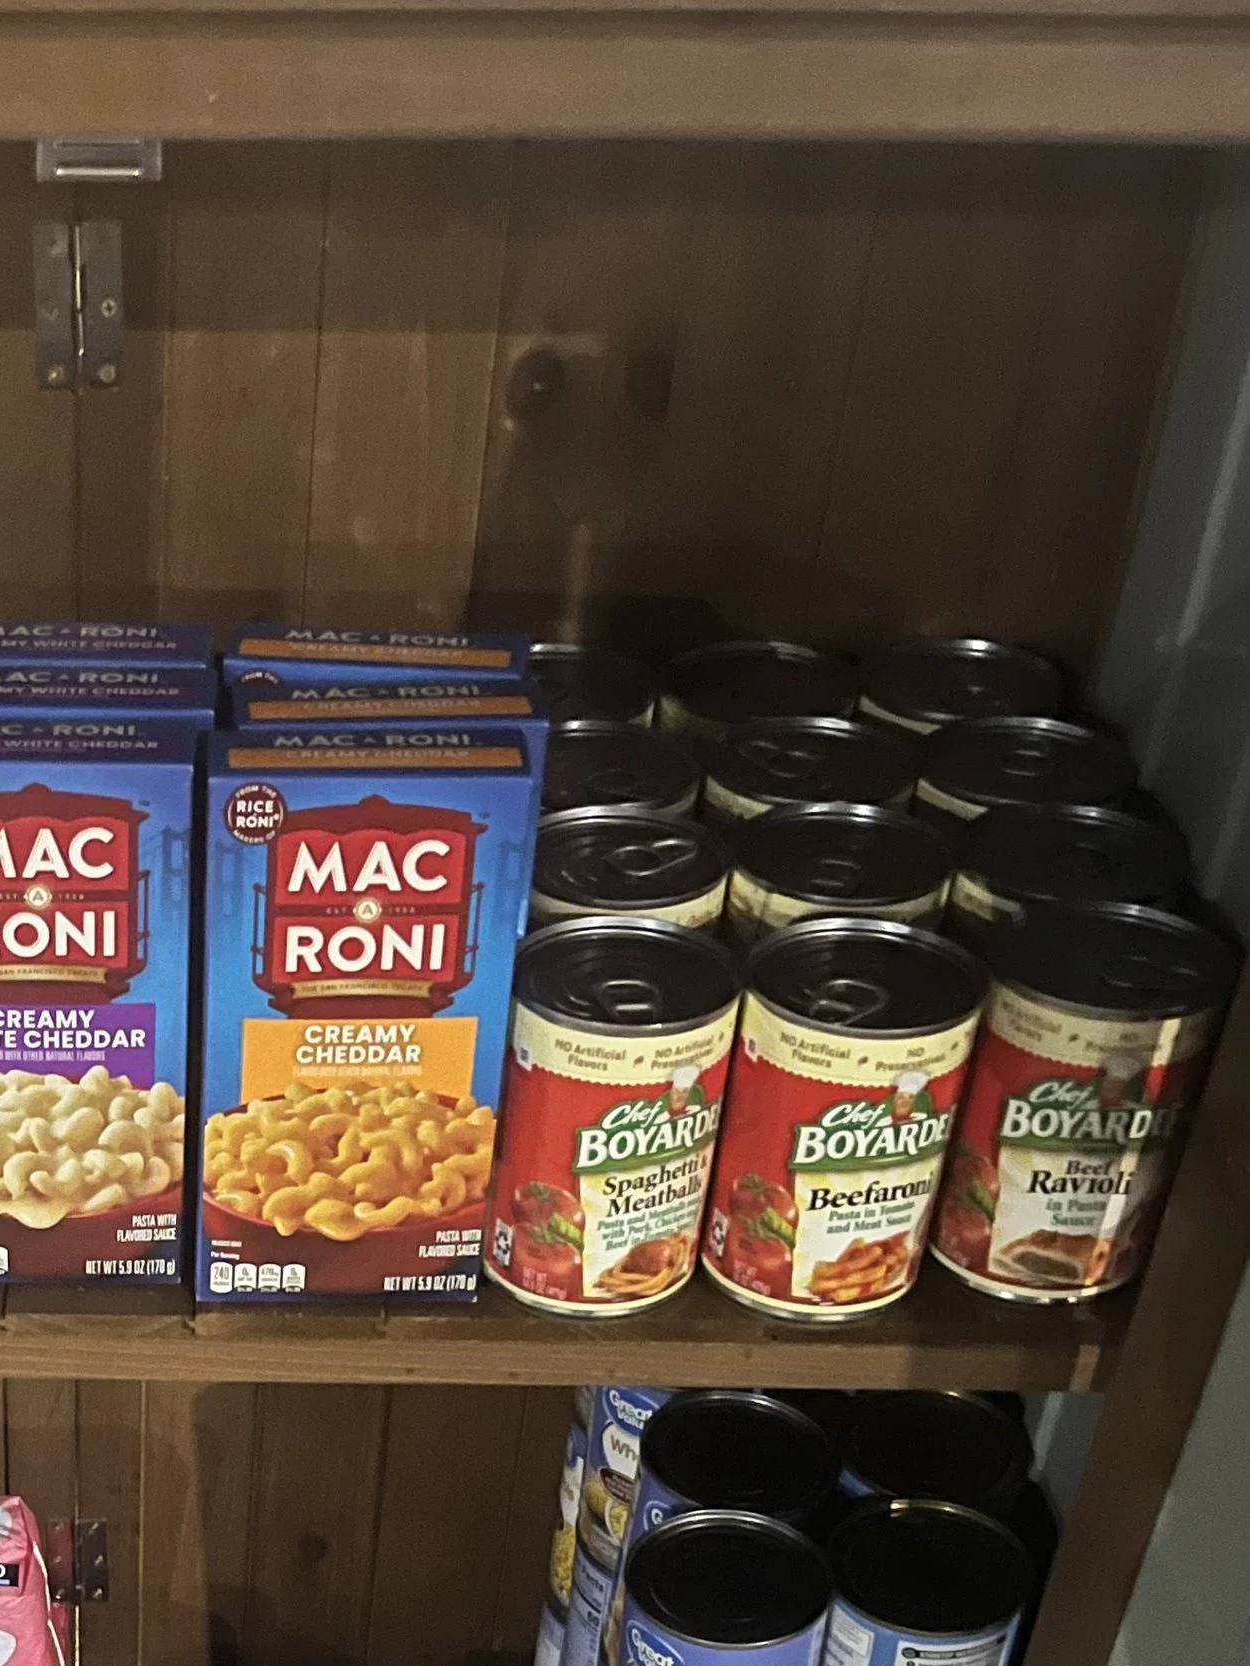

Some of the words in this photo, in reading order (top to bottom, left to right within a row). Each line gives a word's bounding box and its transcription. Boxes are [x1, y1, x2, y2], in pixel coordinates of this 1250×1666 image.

[80, 626, 158, 639] RONI
[285, 629, 362, 643] MAC
[388, 633, 469, 648] RONI
[78, 672, 159, 685] RONI
[291, 686, 364, 701] MAC
[396, 684, 481, 698] RONI
[52, 724, 136, 737] RONI
[273, 734, 354, 748] MAC
[384, 733, 471, 747] RONI
[236, 799, 275, 813] RICE
[287, 838, 451, 894] MAC
[284, 923, 447, 973] RONI
[23, 1028, 147, 1050] CHEDDAR
[304, 1023, 416, 1045] CREAMY
[554, 1038, 573, 1051] NO
[575, 1043, 627, 1062] Artificial
[655, 1047, 673, 1060] NO
[780, 1031, 798, 1047] NO
[799, 1037, 851, 1060] Artificial
[906, 1046, 925, 1059] NO
[295, 1044, 422, 1065] CHEDDAR
[567, 1054, 609, 1072] Flavors
[791, 1048, 833, 1069] Flavors
[1029, 1080, 1095, 1111] Chef
[601, 1100, 663, 1130] Chef
[821, 1101, 887, 1129] Chef
[792, 1113, 951, 1164] BOYARDE
[1065, 1159, 1112, 1176] Beef
[602, 1156, 699, 1198] Spaghetti
[1026, 1169, 1133, 1196] Ravioli
[806, 1171, 934, 1212] Beefaroni
[132, 1214, 156, 1228] PASTA
[156, 1214, 178, 1227] WITH
[828, 1209, 862, 1223] Pasta
[863, 1207, 876, 1218] in
[116, 1228, 152, 1243] FLAVORED
[153, 1228, 178, 1242] SAUCE
[435, 1229, 460, 1243] PASTA
[826, 1221, 850, 1235] and
[456, 1243, 481, 1257] SAUCE
[85, 1259, 102, 1275] NET
[102, 1259, 117, 1275] WT
[118, 1259, 133, 1275] 5.9
[134, 1260, 145, 1275] OZ
[213, 1265, 230, 1282] 240
[383, 1276, 400, 1292] NET
[401, 1276, 417, 1292] WT
[417, 1276, 432, 1291] 5.9
[433, 1276, 445, 1291] OZ
